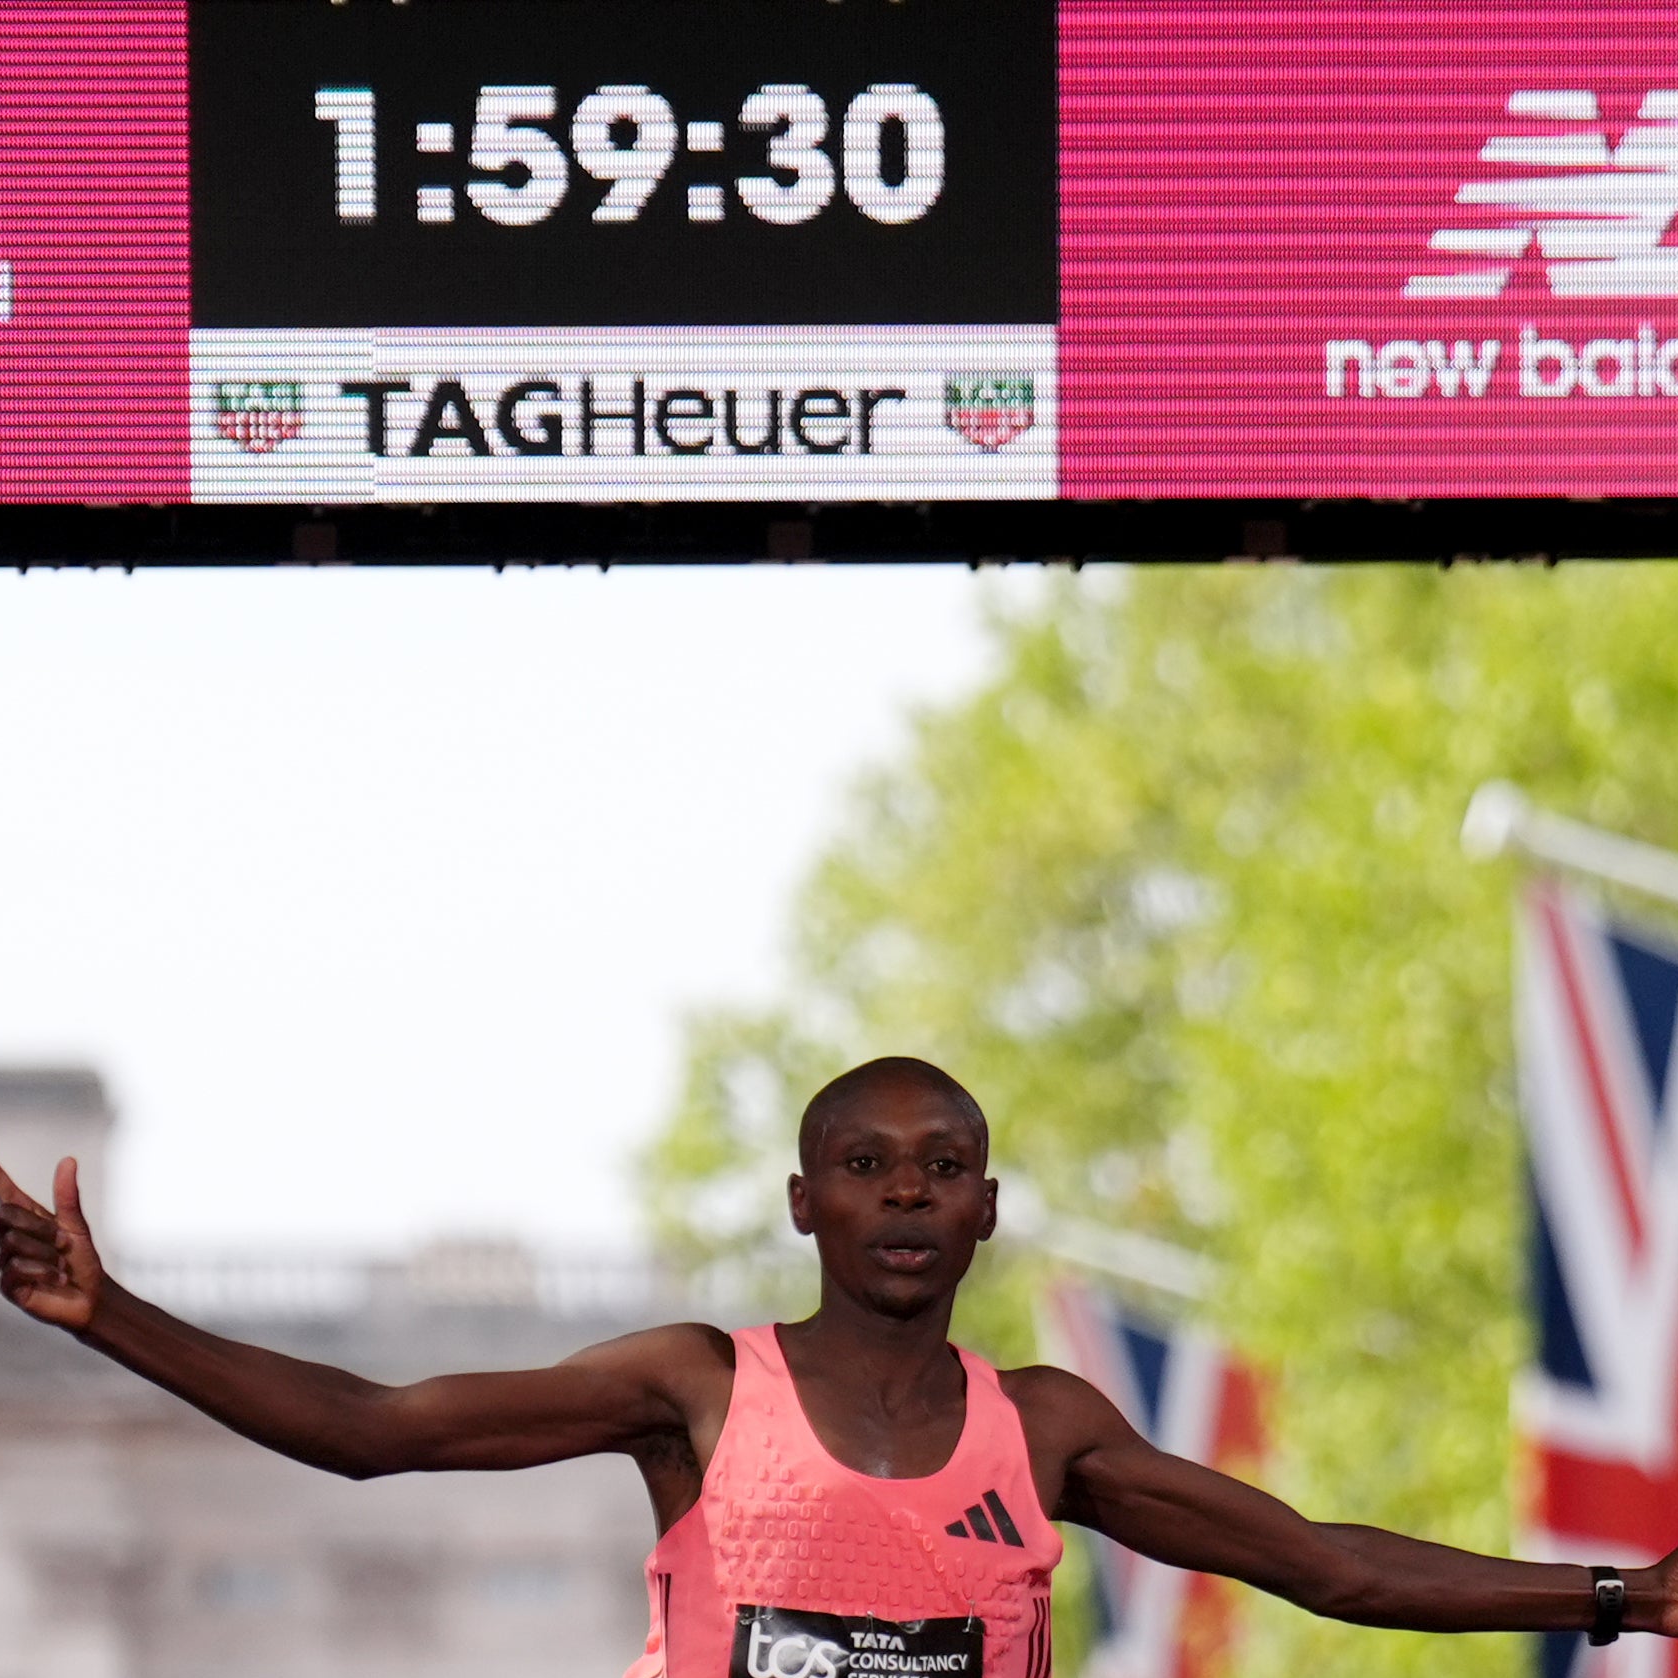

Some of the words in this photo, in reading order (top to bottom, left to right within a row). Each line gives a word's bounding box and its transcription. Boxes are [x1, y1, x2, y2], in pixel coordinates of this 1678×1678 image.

[314, 83, 946, 225] 1:59:30
[1324, 338, 1501, 399] new
[850, 1631, 906, 1651] TATA
[848, 1652, 968, 1672] CONSULTANCY
